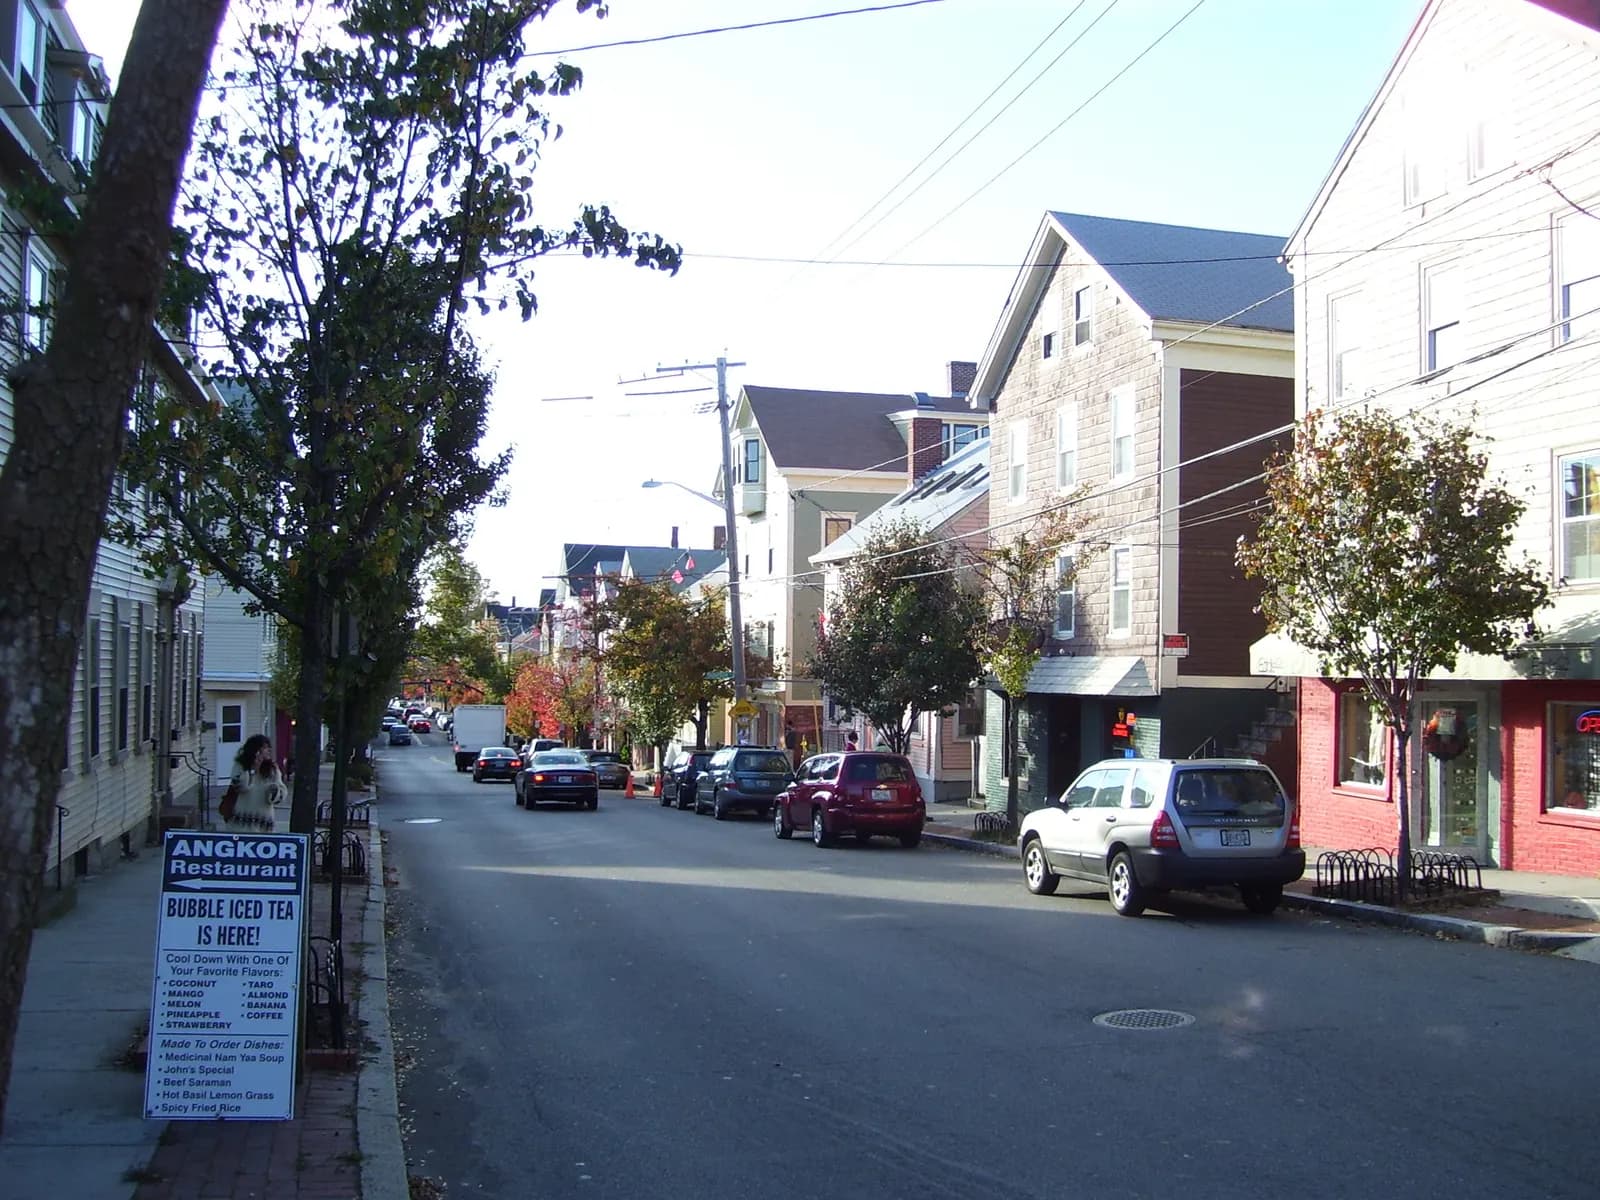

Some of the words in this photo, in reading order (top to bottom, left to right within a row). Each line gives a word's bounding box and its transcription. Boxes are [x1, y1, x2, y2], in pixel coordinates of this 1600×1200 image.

[172, 839, 298, 859] ANGKOR
[170, 859, 297, 877] Restaurant
[167, 897, 224, 918] BUBBLE
[229, 900, 263, 920] ICED
[268, 900, 294, 920] TEA
[197, 925, 212, 945] IS
[217, 926, 260, 946] HERE!
[166, 953, 191, 964] Cool
[194, 954, 223, 964] Down
[226, 955, 250, 965] With
[252, 955, 274, 966] One
[277, 955, 289, 966] Of
[170, 966, 194, 976] Your
[196, 966, 239, 977] Favorite
[241, 967, 284, 977] Flavors:
[168, 980, 217, 988] COCONUT
[248, 981, 274, 989] TARO
[167, 990, 205, 998] MANGO
[247, 991, 289, 999] ALMOND
[167, 1000, 202, 1008] MELON
[166, 1010, 221, 1019] PINEAPPLE
[246, 1012, 284, 1020] COFFEE
[165, 1021, 232, 1030] STRAWBERRY
[160, 1039, 192, 1049] Made
[195, 1040, 207, 1049] To
[209, 1040, 241, 1049] Order
[243, 1040, 285, 1050] Dishes:
[165, 1052, 212, 1062] Medicinal
[214, 1053, 237, 1062] Nam
[240, 1053, 257, 1062] Yaa
[259, 1053, 285, 1065] Soup
[163, 1065, 196, 1074] John's
[199, 1065, 235, 1076] Special
[163, 1078, 187, 1087] Beef
[188, 1078, 232, 1087] Saraman
[162, 1090, 180, 1099] Hot
[182, 1090, 207, 1099] Basil
[209, 1091, 243, 1100] Lemon
[245, 1090, 275, 1100] Grass
[161, 1103, 189, 1113] Spicy
[191, 1103, 217, 1112] Fried
[219, 1103, 241, 1112] Rice
